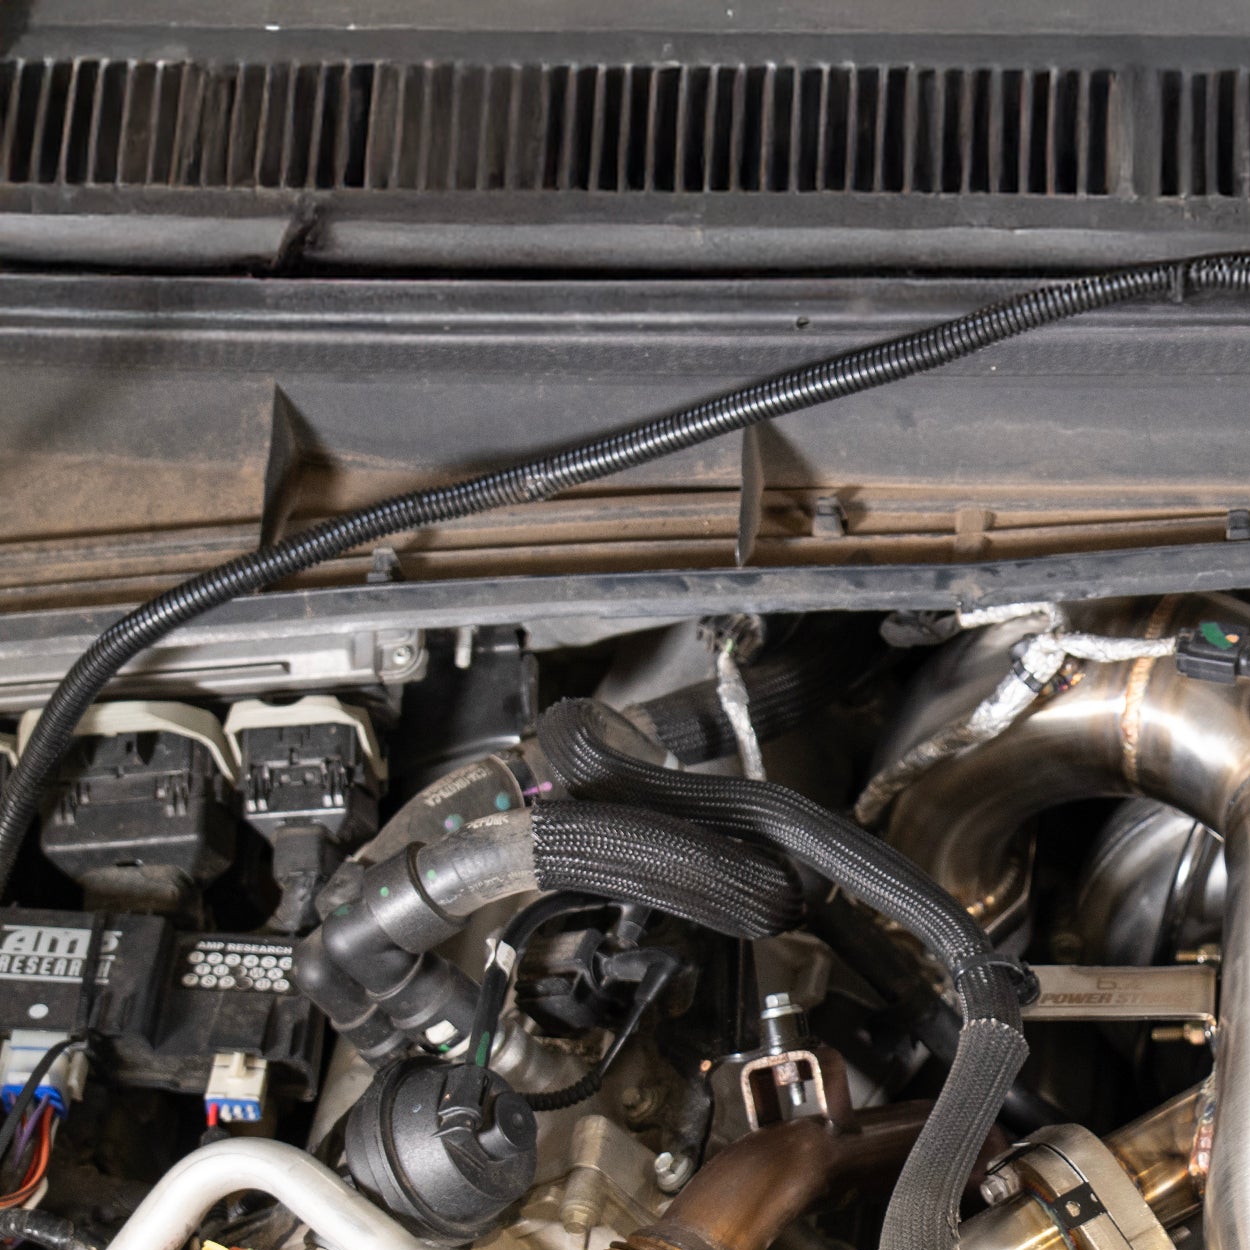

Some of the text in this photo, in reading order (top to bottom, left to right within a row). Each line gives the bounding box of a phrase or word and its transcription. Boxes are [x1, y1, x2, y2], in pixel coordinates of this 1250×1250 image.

[197, 941, 293, 955] AMP RESEARCH
[0, 953, 112, 978] RESEARH
[1040, 992, 1114, 1005] POWER
